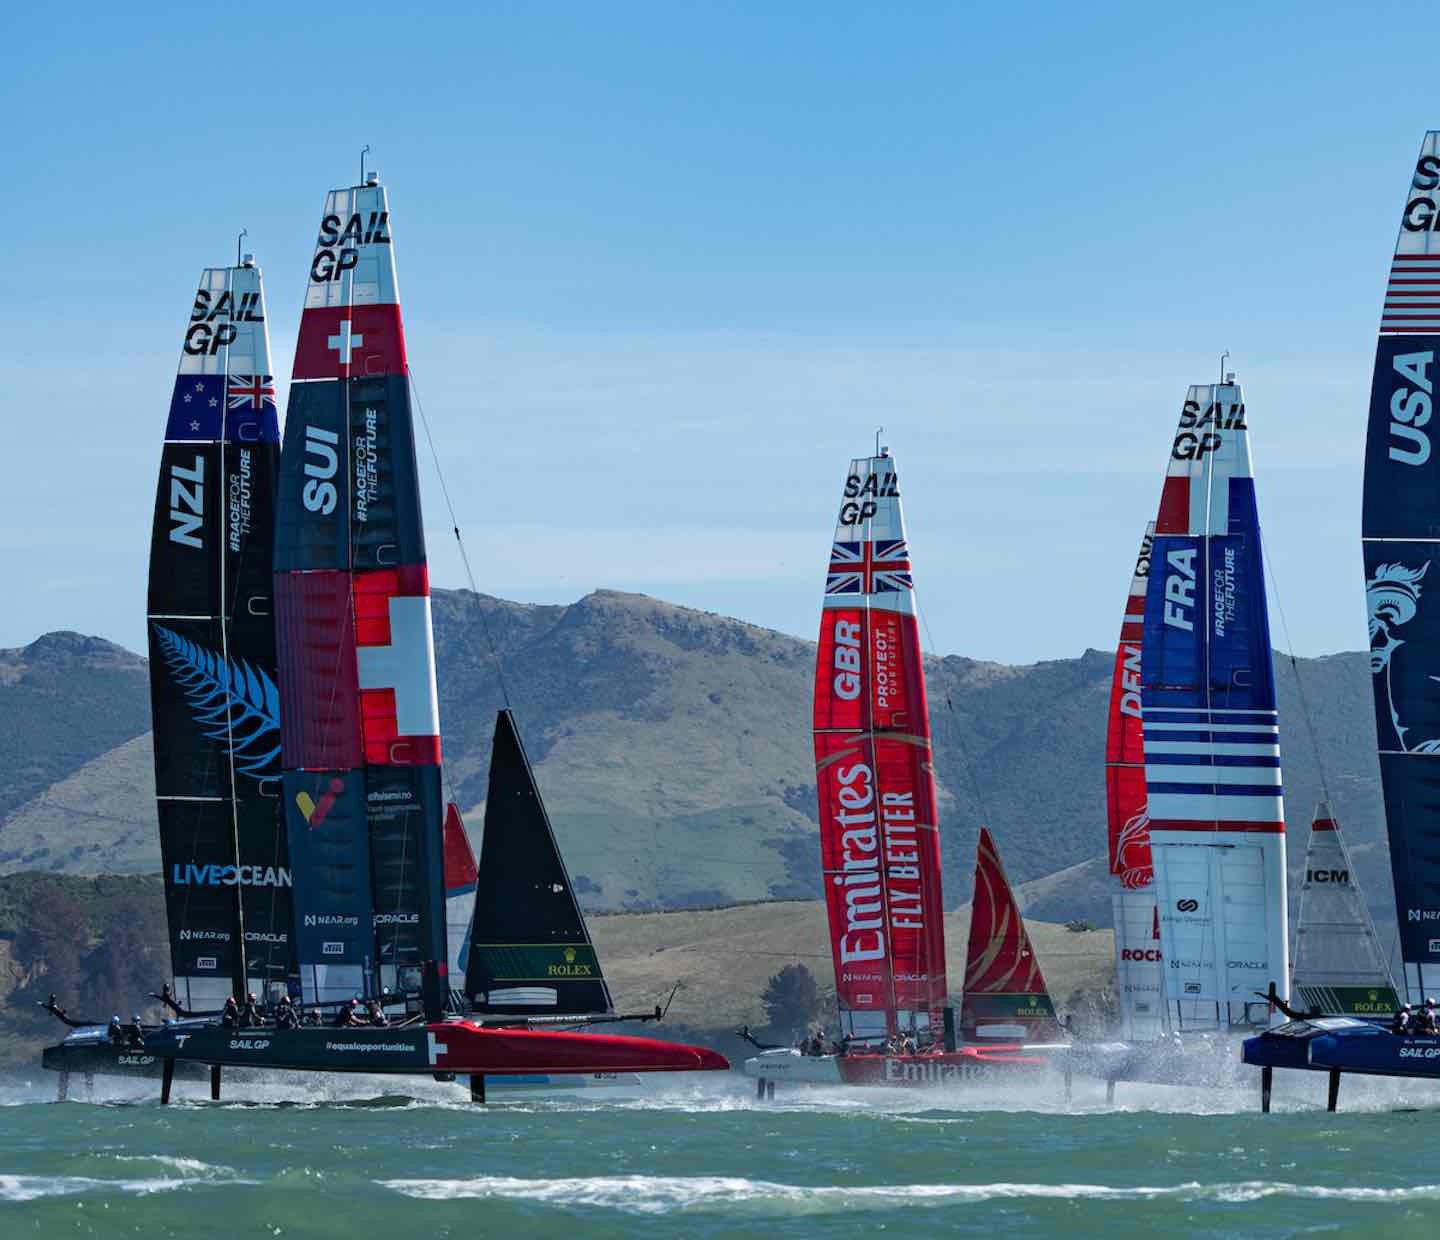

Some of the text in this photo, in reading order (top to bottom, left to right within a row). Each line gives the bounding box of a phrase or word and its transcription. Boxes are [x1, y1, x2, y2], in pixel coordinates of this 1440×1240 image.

[318, 212, 392, 247] SAIL
[311, 249, 359, 282] GP
[190, 289, 264, 321] SAIL
[184, 324, 237, 355] GP
[1179, 400, 1248, 430] SAIL
[1389, 351, 1434, 466] USA
[367, 408, 378, 502] THEFUTURE
[1172, 432, 1221, 460] GP
[303, 425, 339, 515] SUI
[356, 436, 368, 521] #RACEFOR
[844, 473, 900, 498] SAIL
[170, 455, 204, 549] NZL
[240, 448, 251, 536] THEFUTURE
[230, 473, 240, 552] #RACEFOR
[839, 502, 877, 525] GP
[1164, 548, 1197, 632] FRA
[1225, 548, 1235, 621] THEFUTURE
[1215, 569, 1226, 637] #RACEFOR
[834, 620, 862, 700] GBR
[877, 629, 888, 708] PROTECT
[889, 671, 897, 695] OUR
[1120, 646, 1142, 719] DEN
[833, 763, 885, 964] Emirates
[882, 792, 923, 929] FLY BETTER
[1306, 870, 1349, 883] ICM
[318, 916, 359, 926] NEAR.org
[375, 914, 419, 923] ORACLE
[192, 931, 230, 942] NEAR.org
[245, 933, 287, 942] ORACLE
[549, 965, 592, 975] ROLEX
[1017, 1008, 1048, 1016] ROLEX
[1355, 1002, 1392, 1012] ROLEX
[326, 1041, 415, 1052] #equalopportunities
